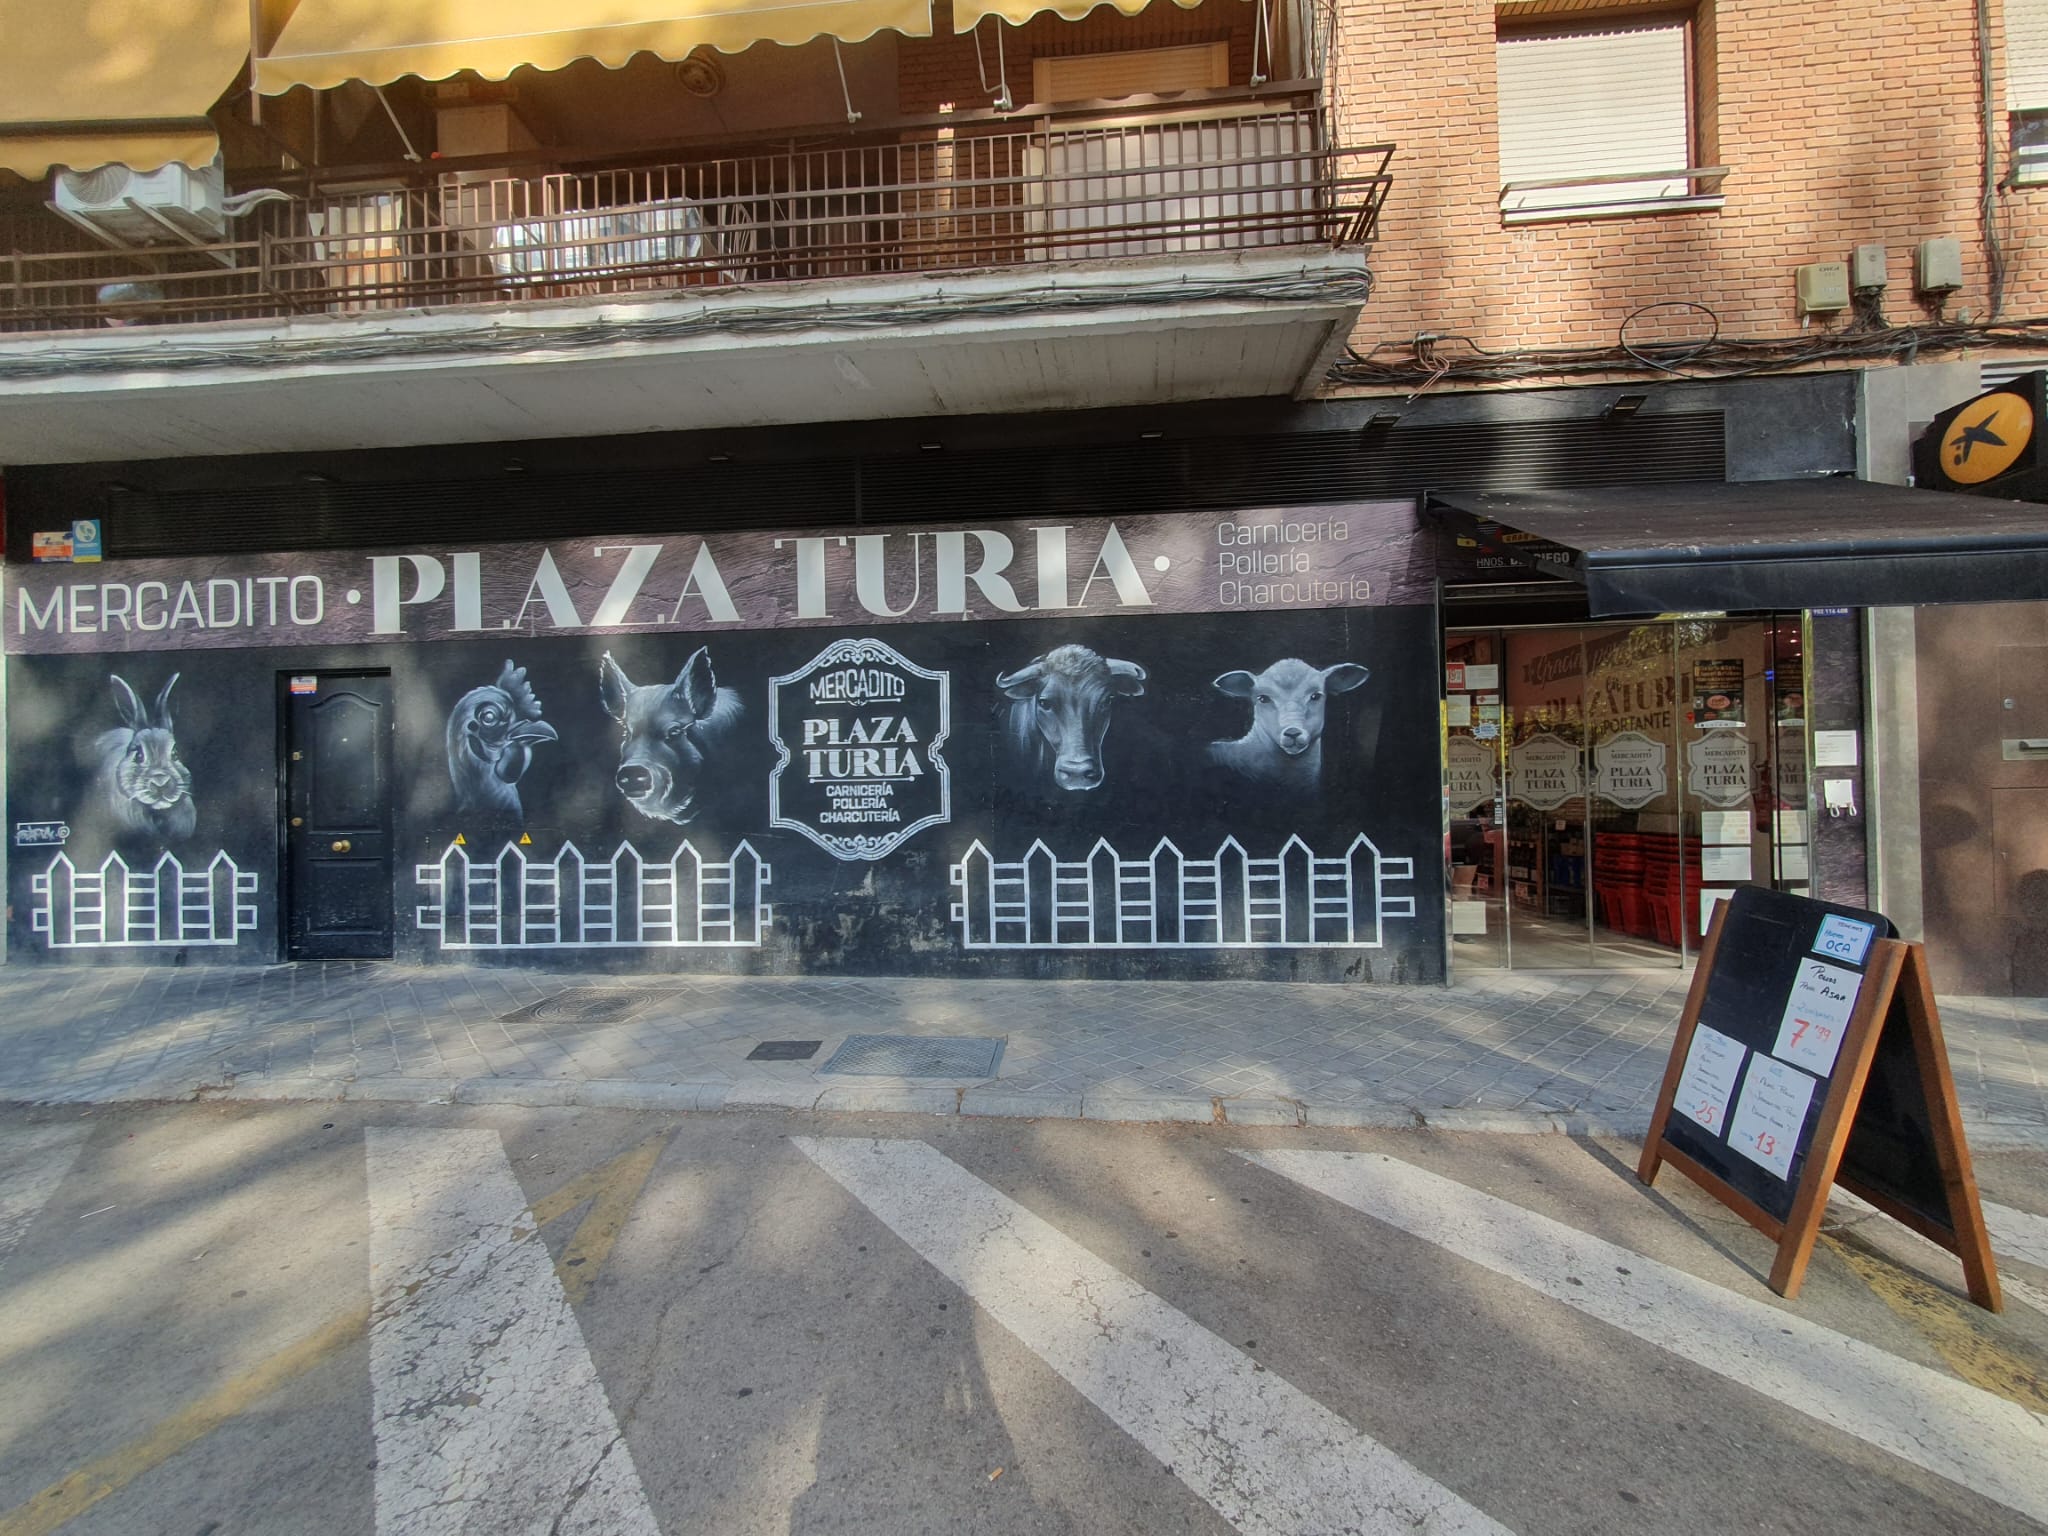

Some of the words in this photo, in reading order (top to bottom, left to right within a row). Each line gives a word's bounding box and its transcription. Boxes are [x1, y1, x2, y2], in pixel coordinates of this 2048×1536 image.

[1218, 515, 1349, 546] Carnicería
[1219, 547, 1310, 576] Pollería
[18, 575, 324, 635] MERCADITO
[366, 540, 746, 635] PLAZA
[774, 522, 1159, 620] TURIA
[1219, 574, 1370, 605] Charcutería
[810, 668, 906, 699] MERCADITO
[803, 716, 919, 745] PLAZA
[1591, 710, 1671, 736] PORTANTE
[803, 747, 924, 778] TURIA
[1703, 764, 1745, 775] PLAZA
[1524, 768, 1566, 779] PLAZA
[1610, 766, 1652, 777] PLAZA
[1449, 782, 1482, 792] URIA
[1524, 780, 1566, 790] TURIA
[1609, 778, 1652, 788] TURIA
[1703, 775, 1746, 786] TURIA
[826, 781, 894, 797] CARNICERÍA
[832, 795, 888, 810] POLLERÍA
[819, 808, 901, 824] CHARCUTERÍA
[1825, 939, 1851, 953] OCA
[1695, 1100, 1718, 1124] 25
[1754, 1131, 1776, 1156] 13
